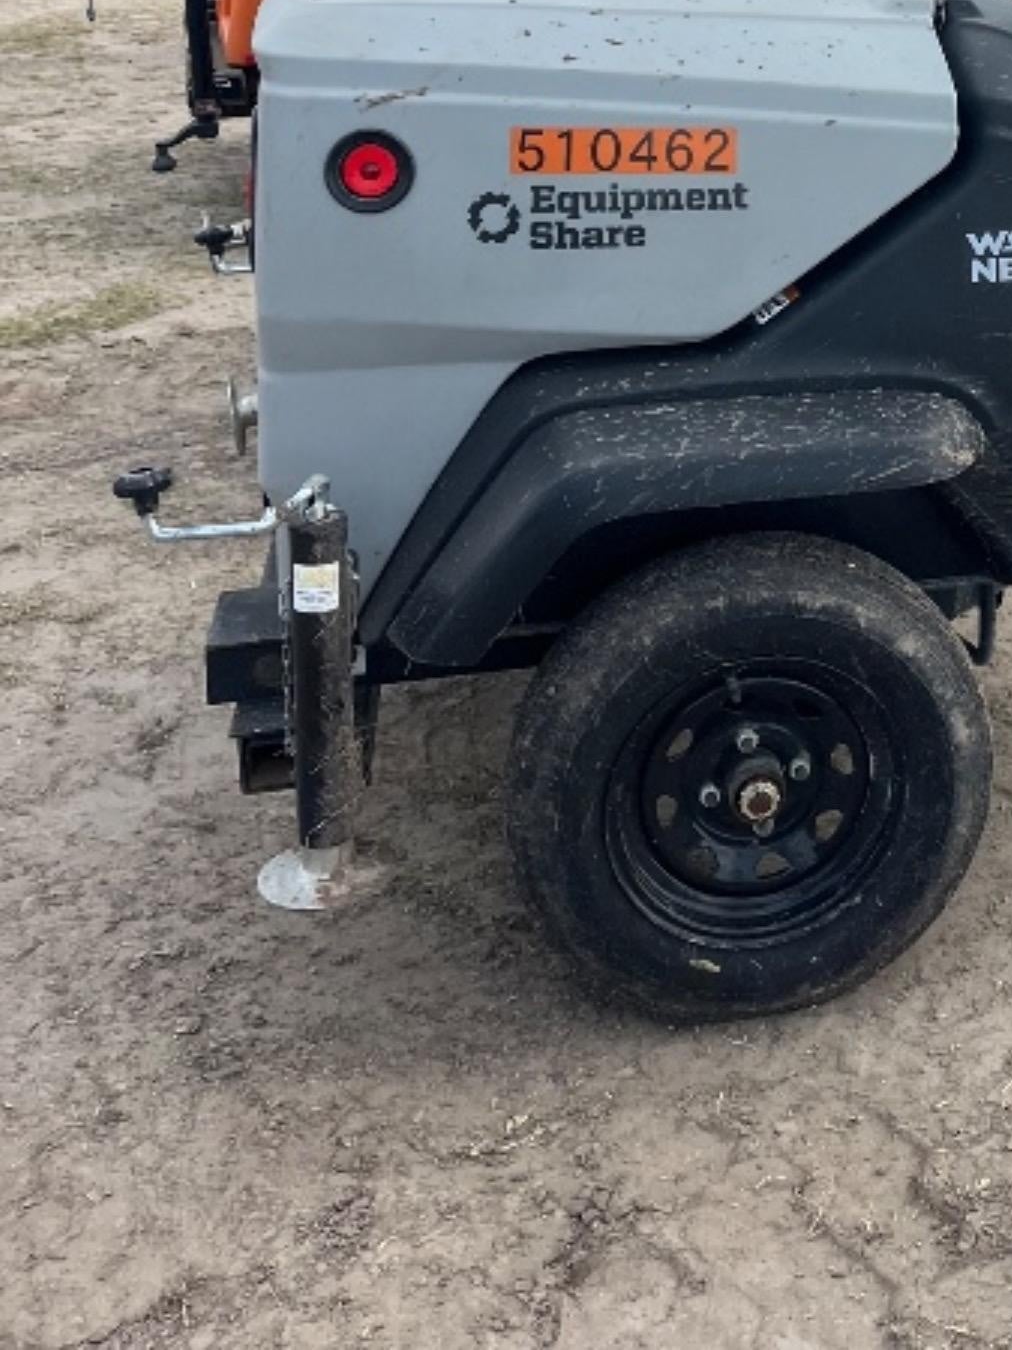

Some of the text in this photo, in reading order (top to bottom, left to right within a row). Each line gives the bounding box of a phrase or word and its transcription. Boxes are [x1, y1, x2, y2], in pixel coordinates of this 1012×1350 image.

[517, 128, 730, 172] 510462
[530, 182, 749, 219] Equipment
[530, 221, 646, 250] Share
